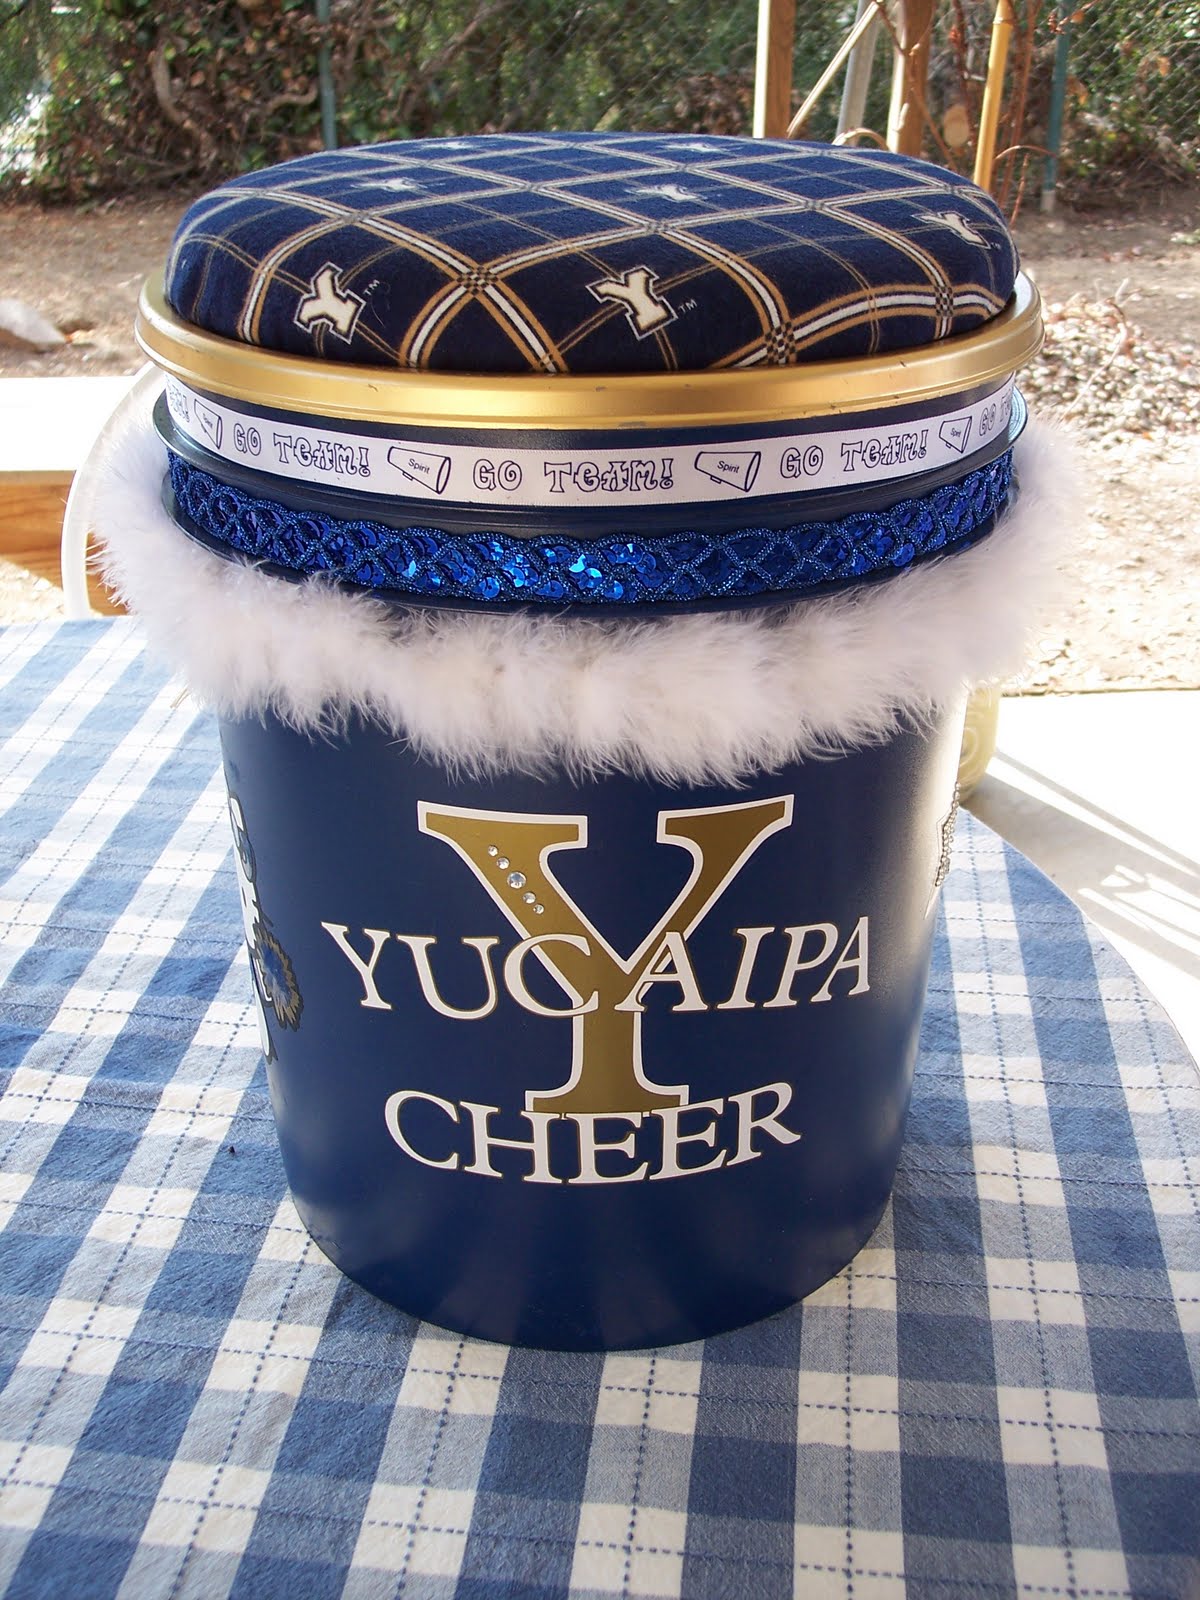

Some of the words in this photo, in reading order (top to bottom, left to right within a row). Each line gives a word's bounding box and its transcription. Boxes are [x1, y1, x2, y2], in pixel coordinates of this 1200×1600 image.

[233, 423, 261, 456] GO
[408, 458, 431, 475] Spirit
[473, 459, 522, 491] GO
[717, 459, 740, 475] Spirit
[779, 445, 824, 478] GO
[321, 916, 871, 1020] YUCAIPA
[417, 794, 794, 1117] Y
[385, 1081, 801, 1184] CHEER
